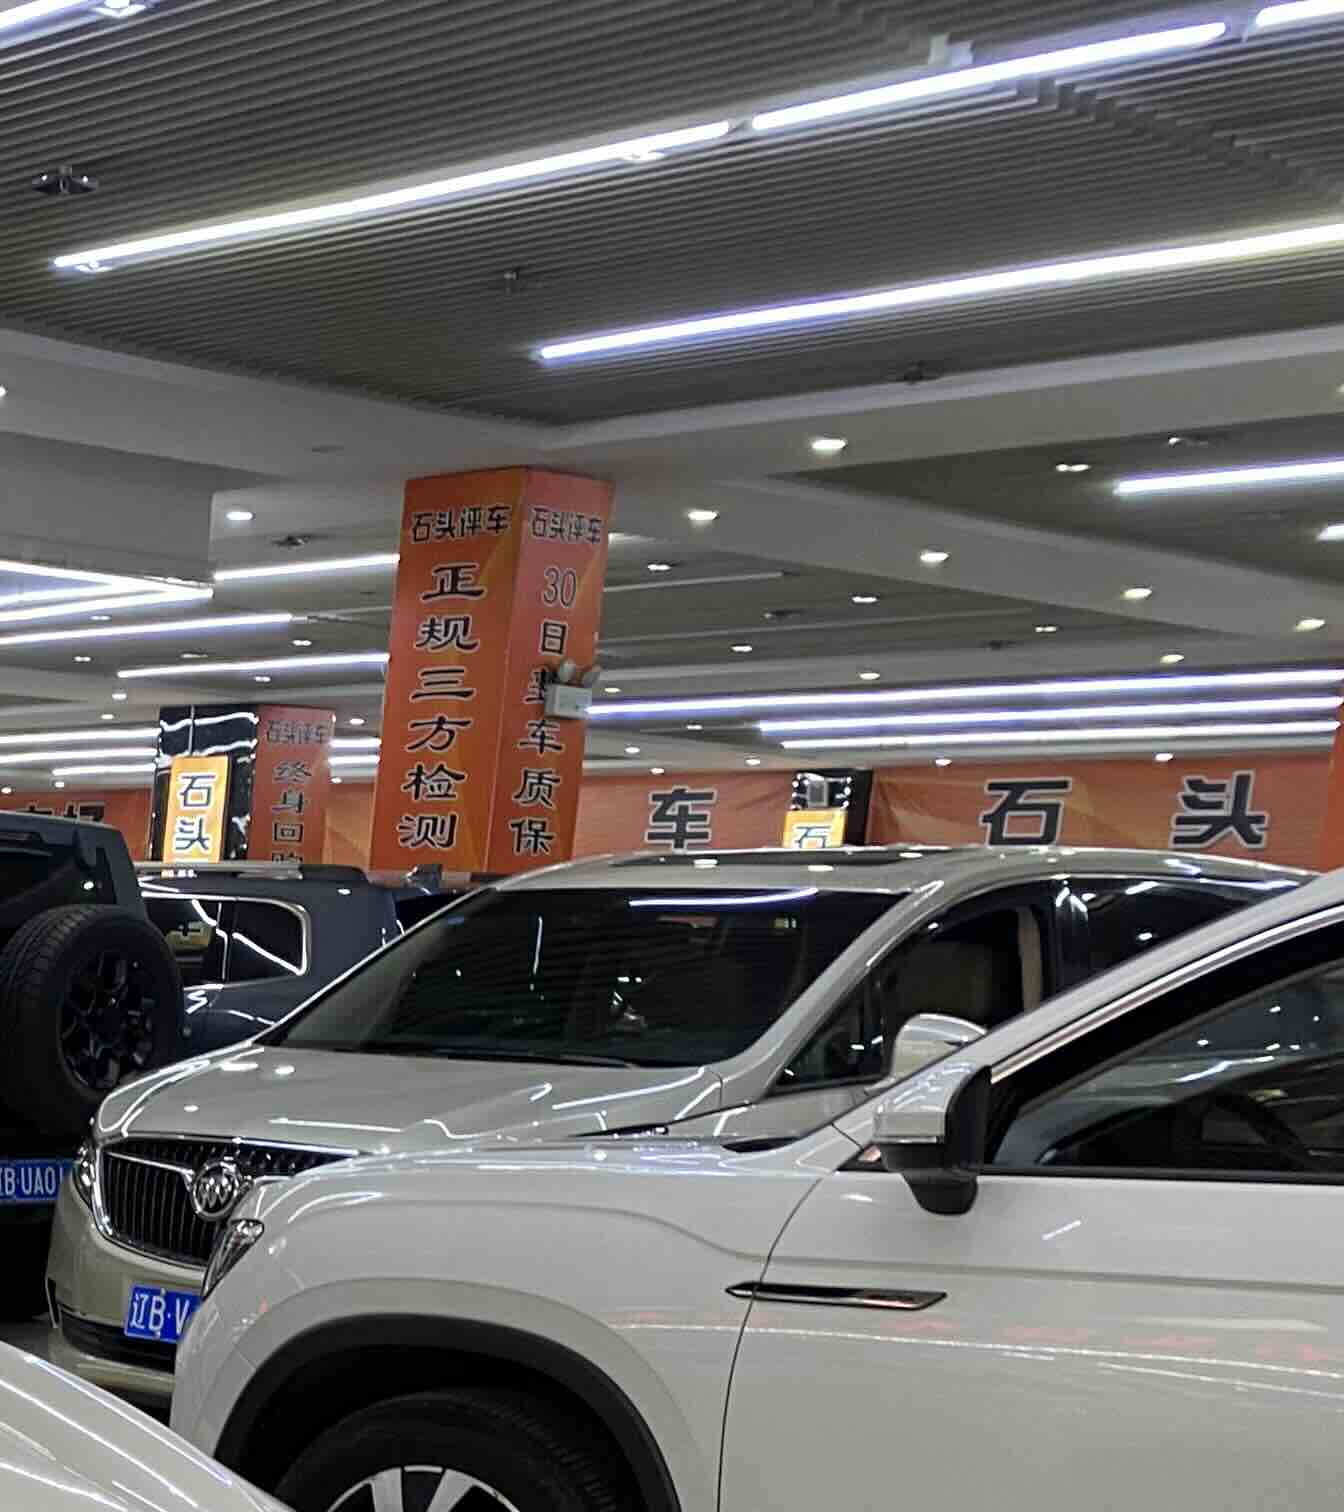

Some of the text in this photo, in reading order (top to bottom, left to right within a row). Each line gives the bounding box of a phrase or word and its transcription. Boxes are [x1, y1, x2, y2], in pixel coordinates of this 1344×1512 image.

[411, 503, 515, 545] 石头评车
[529, 505, 604, 546] 石头评车
[396, 562, 488, 851] 正规三方检测
[647, 786, 715, 852] 车
